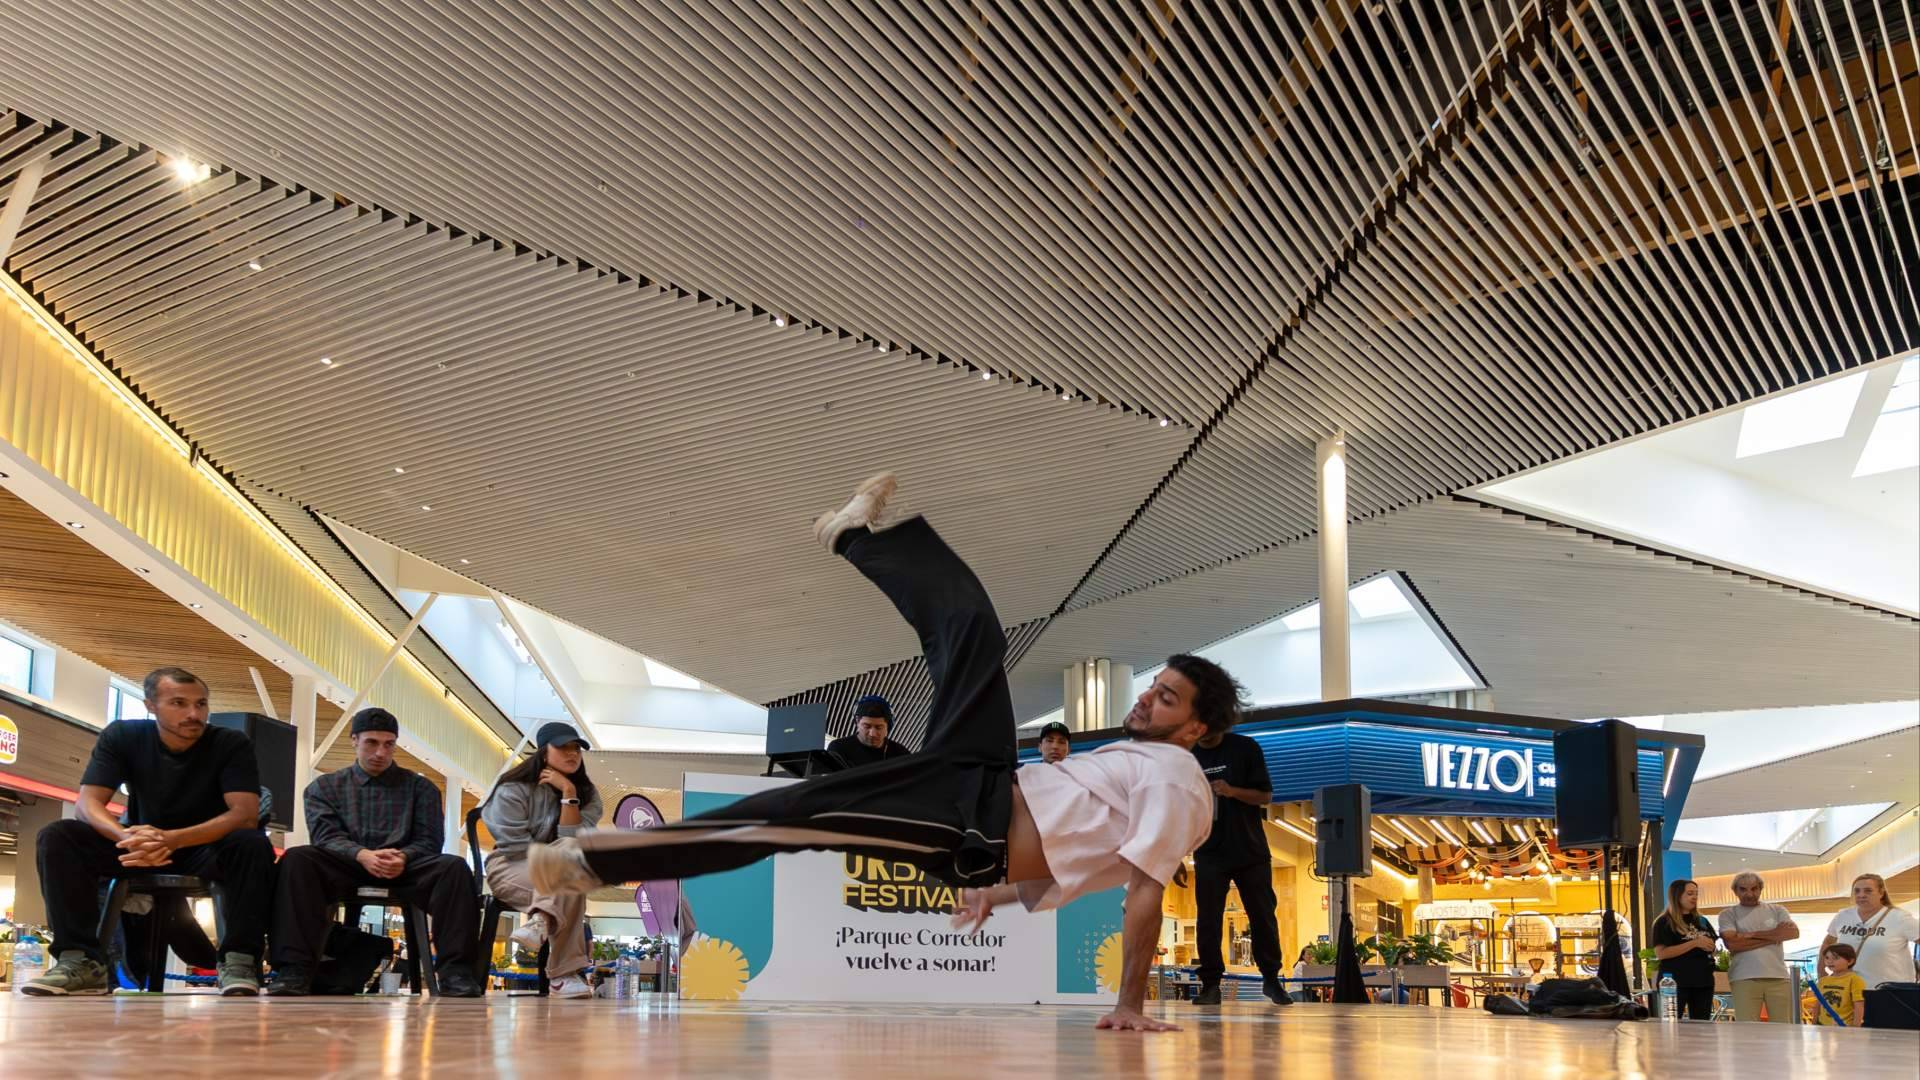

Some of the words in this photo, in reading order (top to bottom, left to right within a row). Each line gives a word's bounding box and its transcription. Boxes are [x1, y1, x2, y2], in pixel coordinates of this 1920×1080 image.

[1421, 742, 1529, 794] VEZZO
[843, 884, 971, 909] FESTIVAL
[836, 927, 912, 949] ¡Parque
[917, 929, 1006, 948] Corredor
[846, 953, 912, 970] vuelve
[917, 957, 928, 971] a
[933, 956, 996, 972] sonar!
